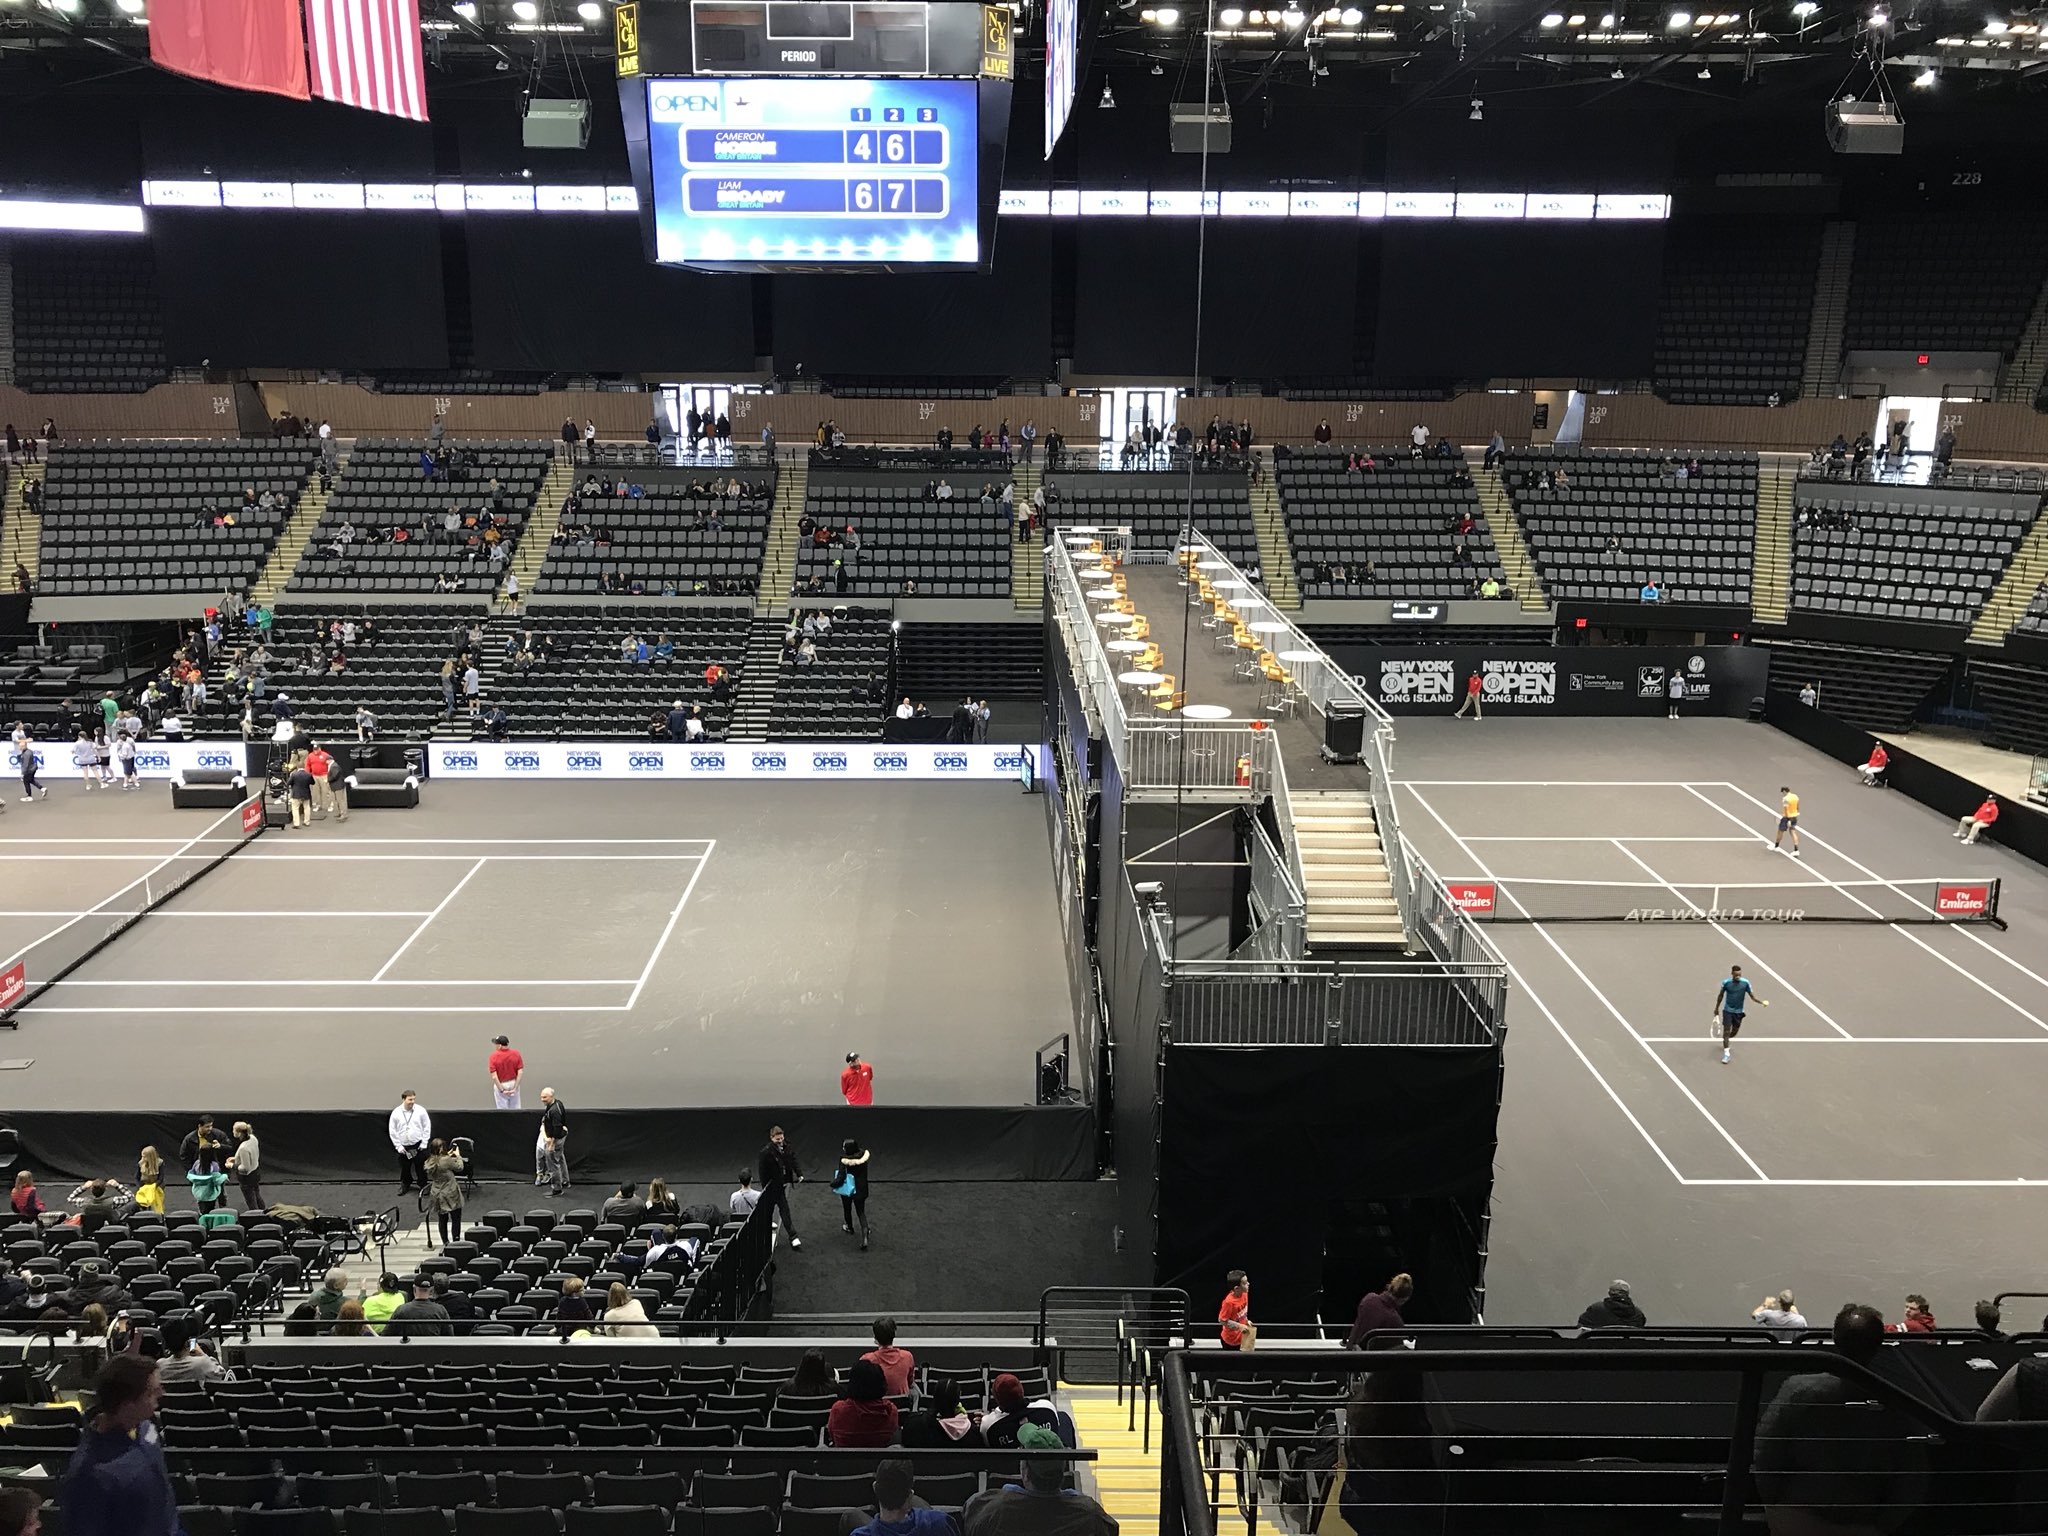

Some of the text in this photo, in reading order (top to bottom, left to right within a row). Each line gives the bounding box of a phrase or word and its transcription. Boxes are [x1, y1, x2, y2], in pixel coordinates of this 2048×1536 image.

[781, 50, 816, 62] PERIOD
[619, 55, 638, 72] LIVE
[985, 57, 1008, 73] LIVE
[655, 96, 718, 112] OPEN
[856, 108, 932, 121] 1 2 3
[716, 132, 764, 141] CAMERON
[853, 134, 904, 161] 4 6
[1952, 172, 1982, 184] 228
[718, 181, 742, 190] LIAM
[855, 183, 904, 209] 6 7
[435, 398, 451, 406] 115
[736, 400, 751, 408] 116
[920, 402, 934, 410] 117
[1347, 404, 1364, 412] 119
[1590, 406, 1607, 414] 120
[920, 412, 930, 420] 17
[1346, 414, 1358, 422] 19
[1944, 415, 1962, 424] 121
[1381, 660, 1454, 672] NEW YORK
[1482, 661, 1556, 674] NEW YORK
[1380, 672, 1454, 694] OPEN
[1482, 673, 1556, 694] OPEN
[1380, 694, 1454, 702] LONG ISLAND
[1482, 694, 1555, 704] LONG ISLAND
[135, 756, 170, 766] OPEN
[198, 756, 232, 766] OPEN
[443, 756, 477, 766] OPEN
[505, 757, 539, 766] OPEN
[567, 757, 601, 766] OPEN
[629, 757, 663, 767] OPEN
[691, 757, 725, 767] OPEN
[752, 757, 786, 767] OPEN
[813, 757, 846, 767] OPEN
[874, 757, 908, 767] OPEN
[934, 758, 968, 767] OPEN
[994, 758, 1022, 767] OPE
[1464, 890, 1477, 898] Fly
[1956, 892, 1970, 900] Fly
[1940, 899, 1983, 909] Emirates
[1624, 908, 1666, 921] ATP
[1752, 908, 1806, 921] TOUR
